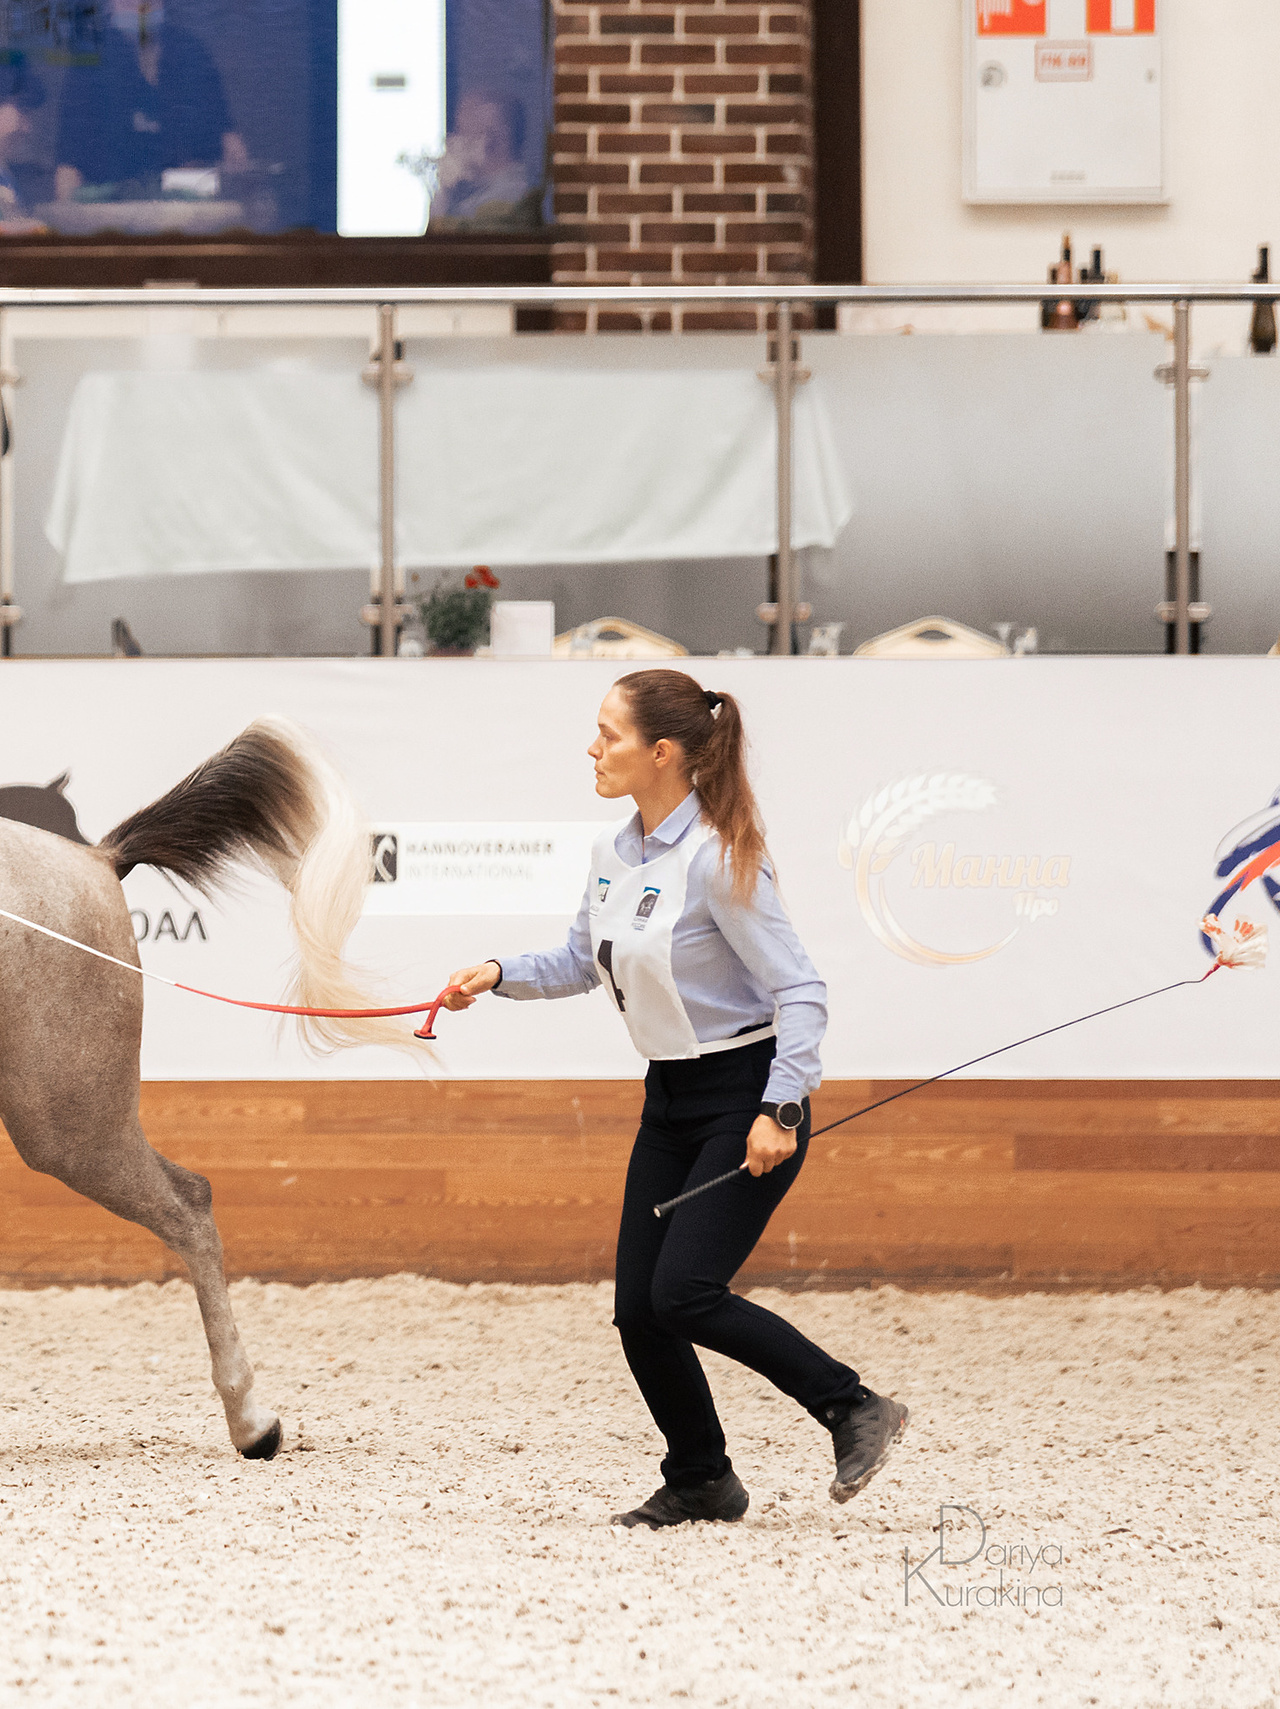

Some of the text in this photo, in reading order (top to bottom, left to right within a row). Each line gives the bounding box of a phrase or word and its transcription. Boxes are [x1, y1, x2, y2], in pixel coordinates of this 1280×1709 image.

[406, 840, 554, 856] HANNOVERANER
[405, 863, 534, 879] INTERNATIONAL
[911, 841, 1071, 888] Манна
